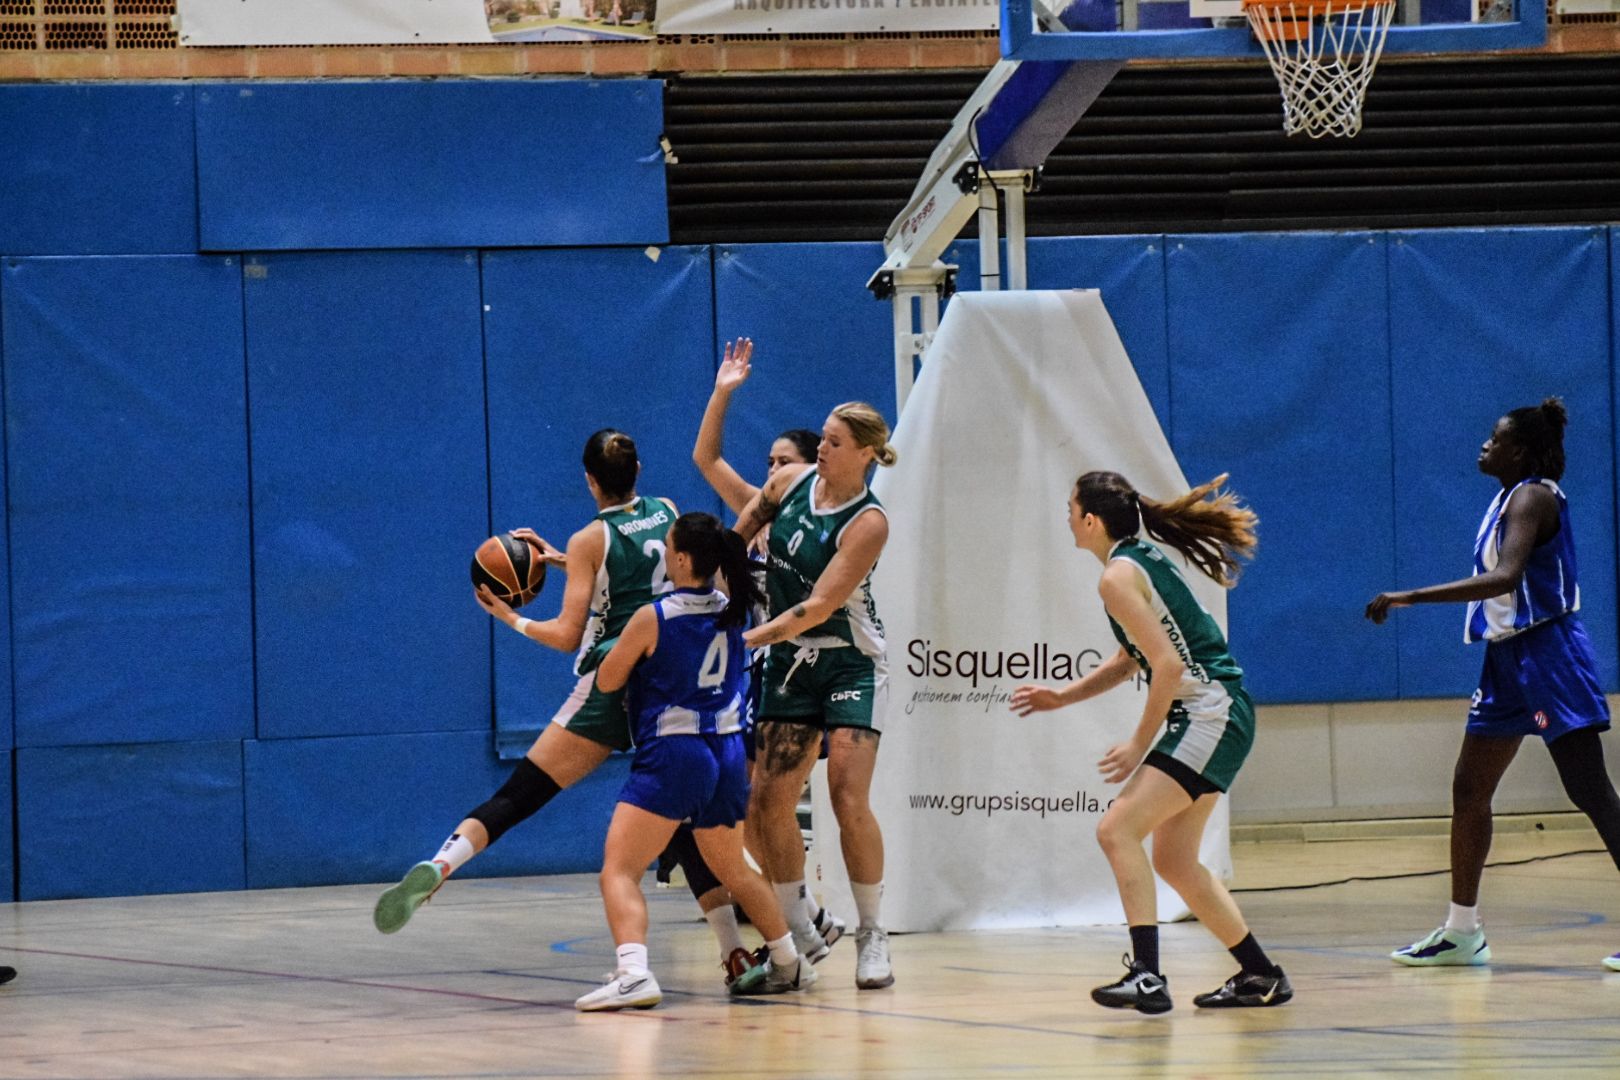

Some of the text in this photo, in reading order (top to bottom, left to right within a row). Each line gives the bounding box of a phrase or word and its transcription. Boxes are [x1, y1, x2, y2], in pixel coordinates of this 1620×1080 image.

[787, 529, 804, 557] 0
[697, 631, 728, 688] 4
[907, 639, 1148, 691] SisquellaGp
[1161, 614, 1211, 685] CRANYOLA
